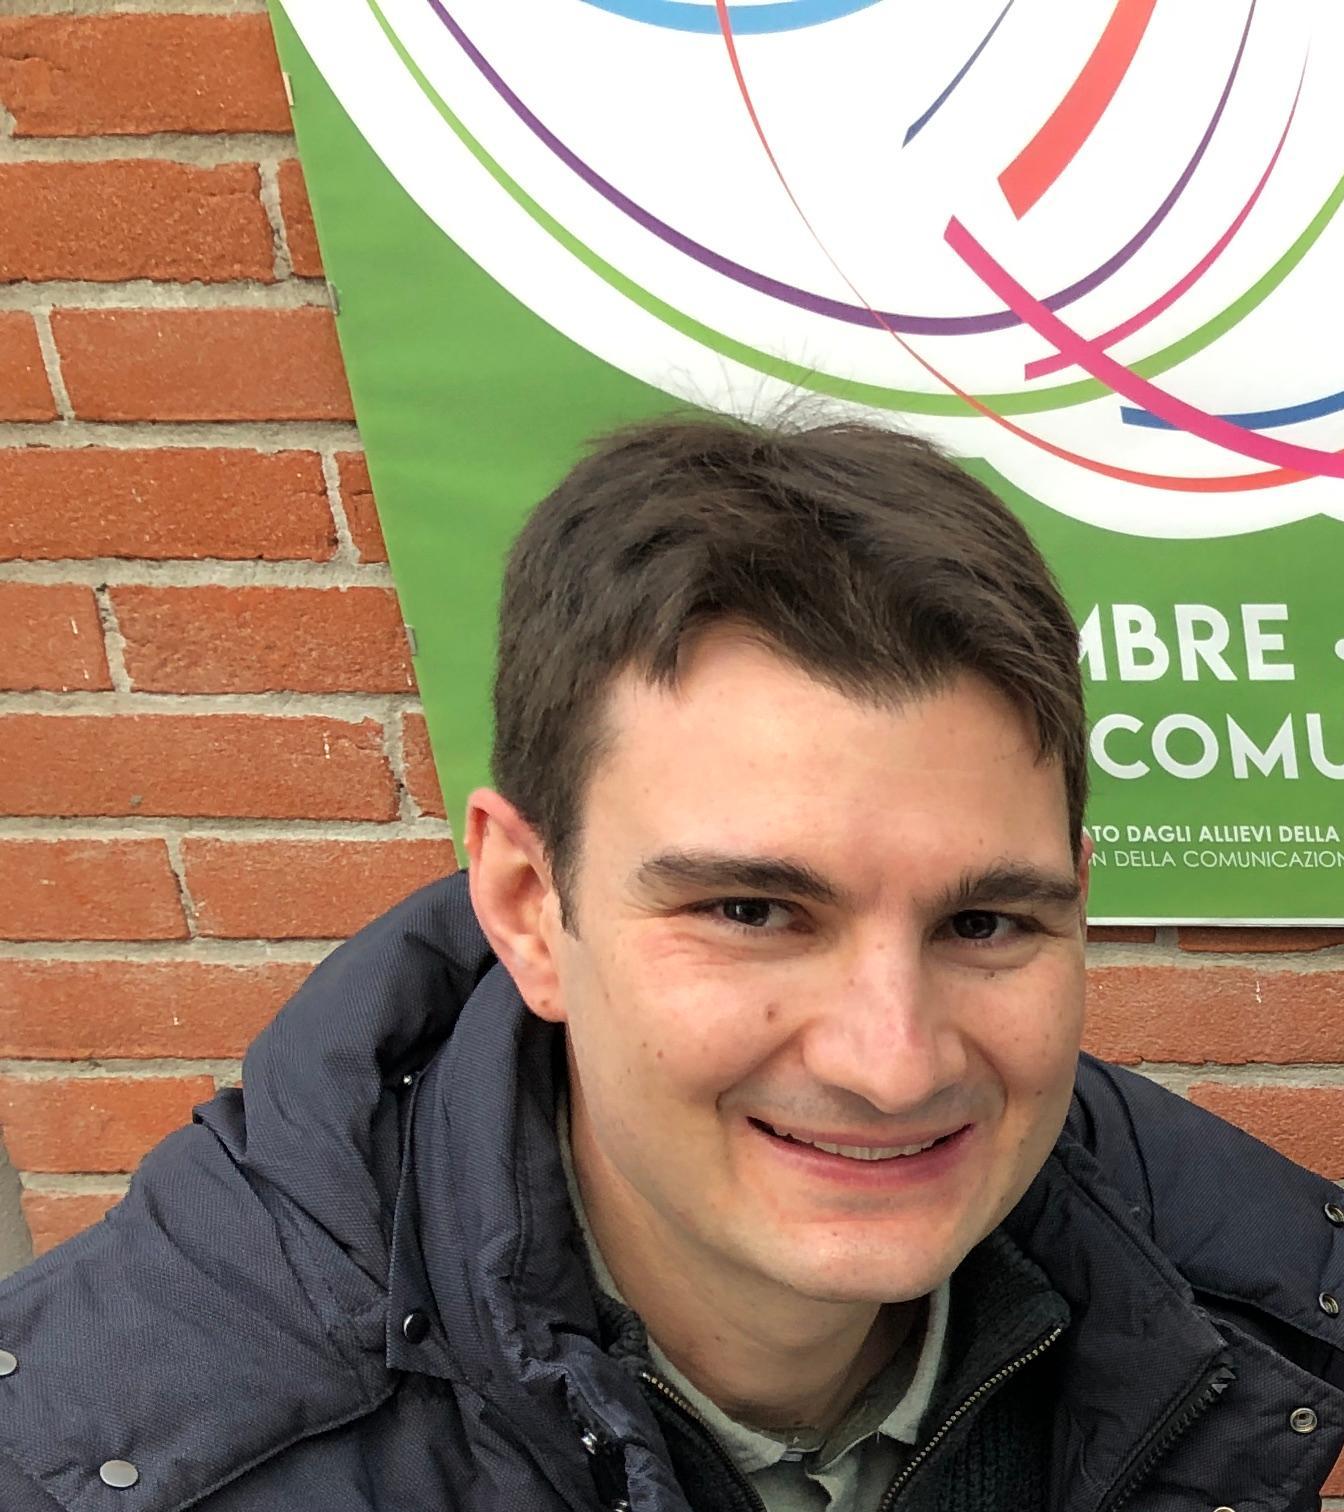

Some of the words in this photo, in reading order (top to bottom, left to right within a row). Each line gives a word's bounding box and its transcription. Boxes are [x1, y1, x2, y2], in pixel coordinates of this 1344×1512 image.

[1126, 825, 1191, 843] DAGLI
[1198, 825, 1272, 843] ALLIEVI
[1278, 825, 1341, 843] DELLA
[1114, 850, 1176, 867] DELLA
